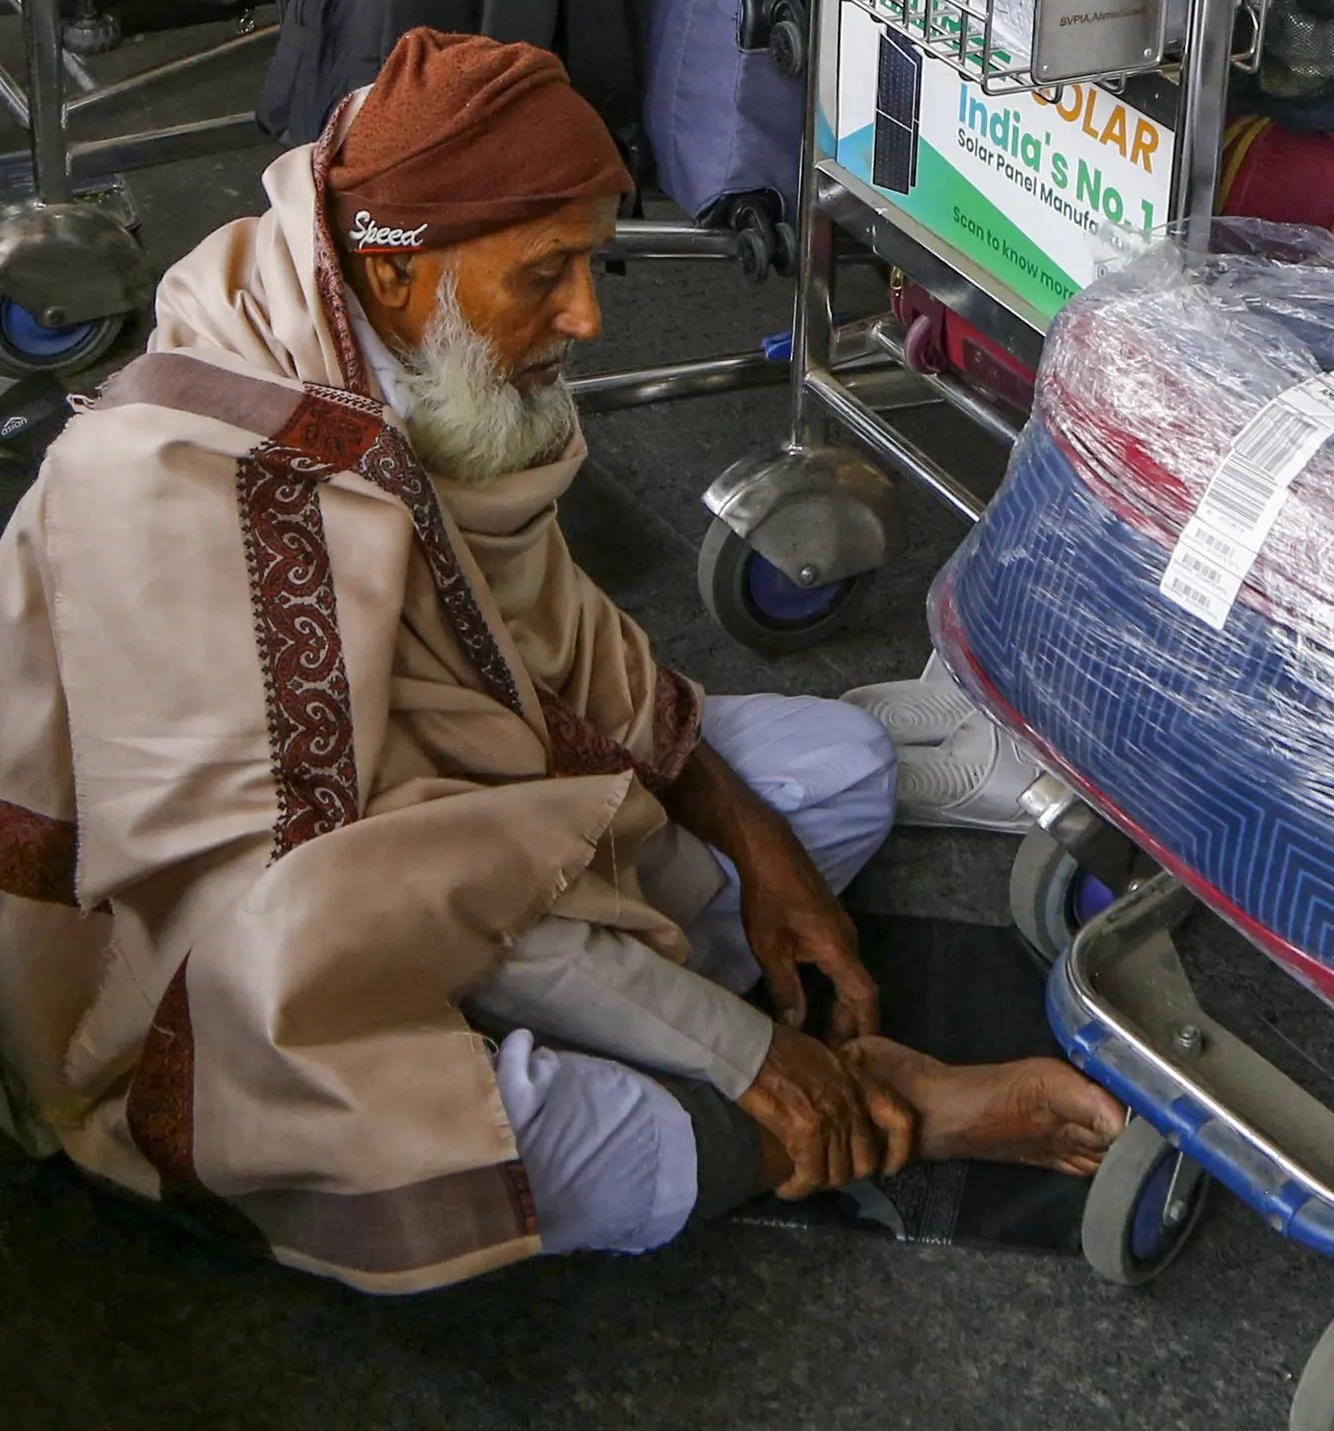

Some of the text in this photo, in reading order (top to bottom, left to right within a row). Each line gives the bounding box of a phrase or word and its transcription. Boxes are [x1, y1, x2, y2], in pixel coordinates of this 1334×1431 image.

[958, 83, 1069, 190] India's
[957, 128, 1100, 238] Solar Panel Manufa
[349, 210, 428, 251] Speed
[953, 205, 985, 242] Scan
[987, 231, 1000, 252] to
[1002, 240, 1038, 279] know
[1, 418, 27, 436] asian
